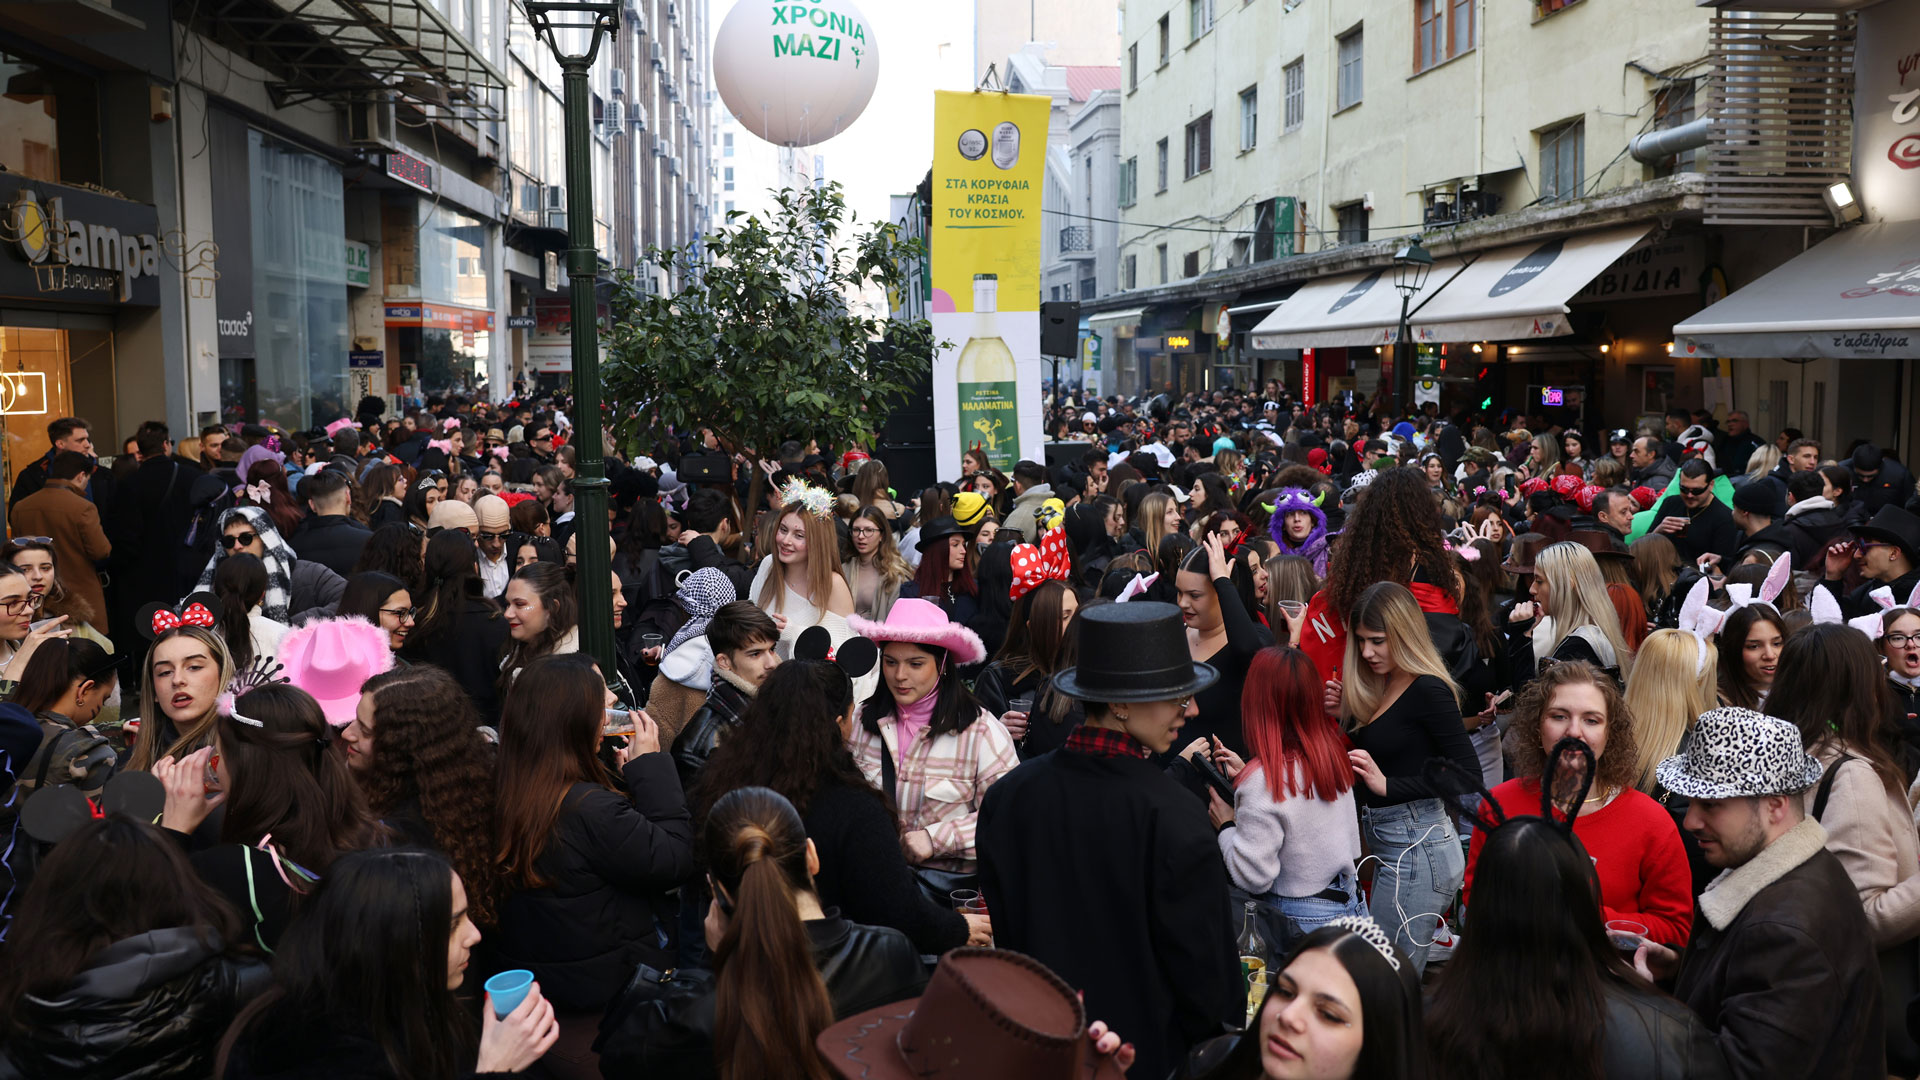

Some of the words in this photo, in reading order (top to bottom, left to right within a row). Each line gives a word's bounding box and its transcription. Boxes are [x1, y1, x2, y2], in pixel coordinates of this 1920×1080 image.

[771, 5, 865, 46] ΧΡΟΝΙΑ
[773, 33, 841, 61] ΜΑΖΙ
[945, 178, 968, 189] ΣΤΑ
[971, 179, 1030, 191] ΚΟΡΥΦΑΙΑ
[948, 208, 972, 218] ΤΟΥ
[974, 208, 1025, 219] ΚΟΣΜΟΥ.
[967, 194, 1009, 205] ΚΡΑΣΙΑ
[51, 196, 160, 302] lampa
[1311, 611, 1336, 644] N
